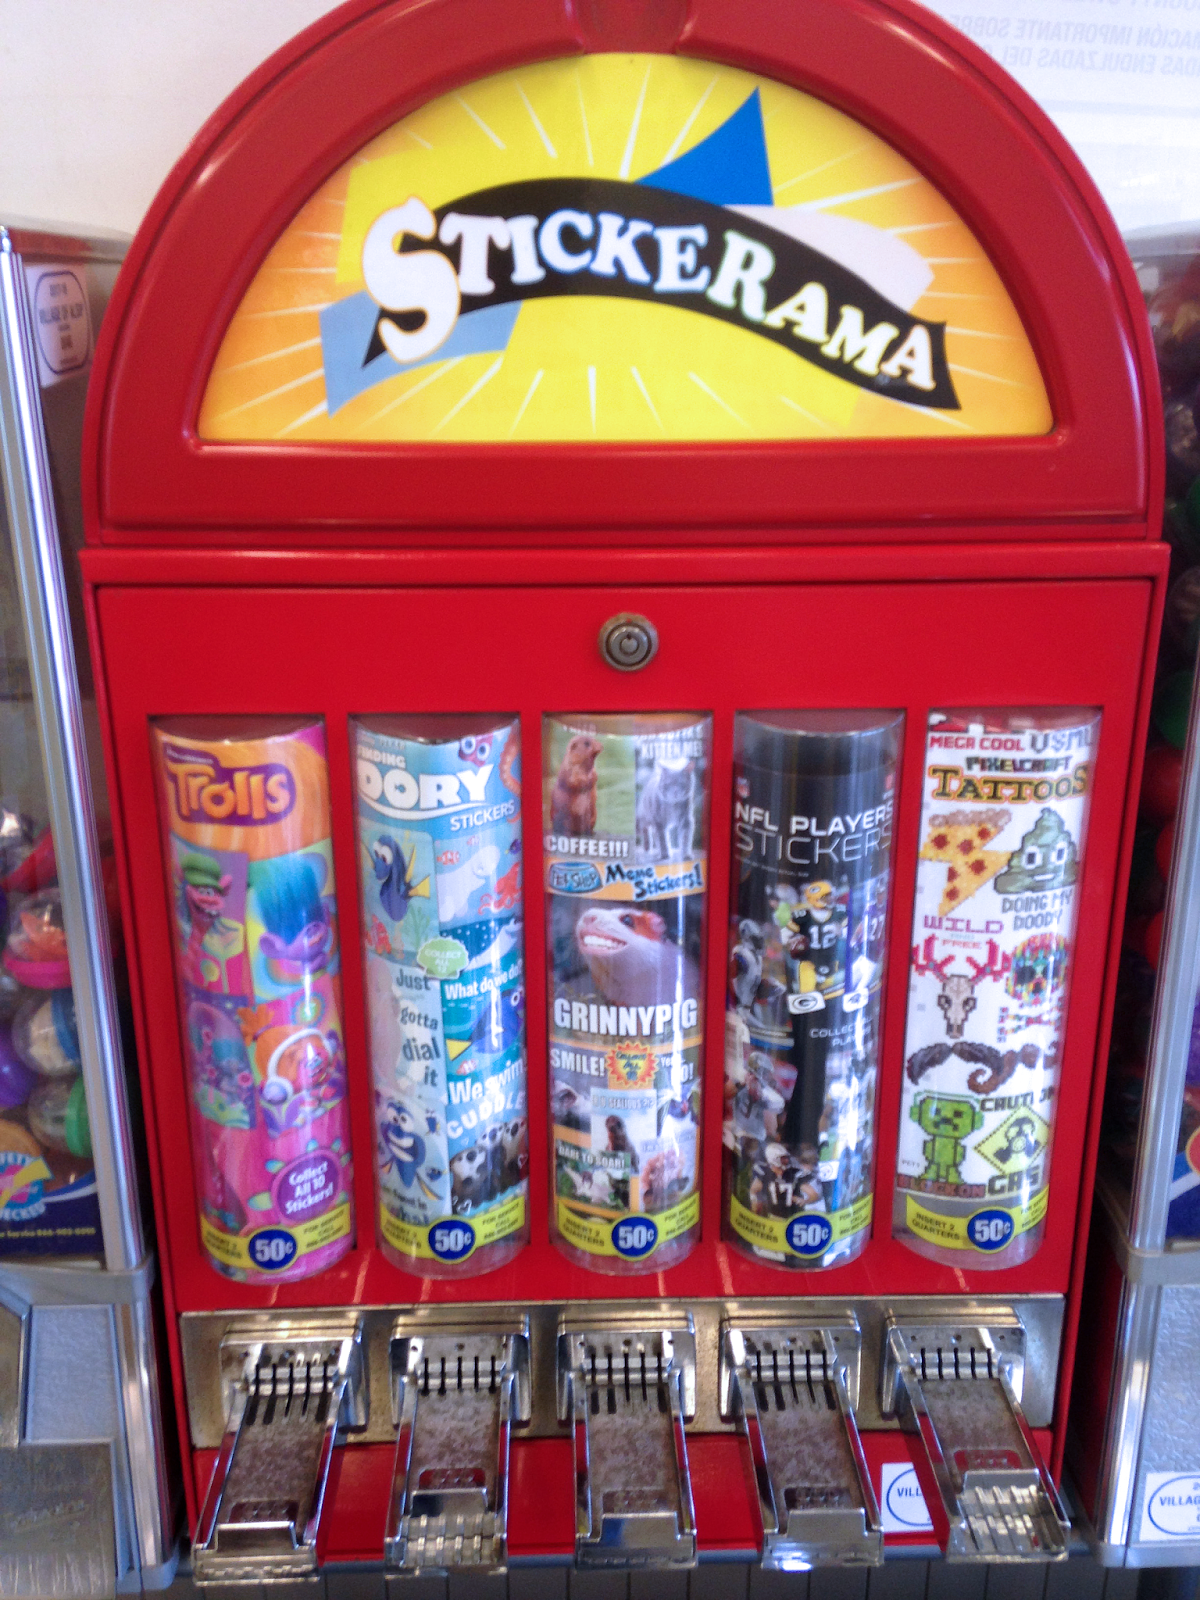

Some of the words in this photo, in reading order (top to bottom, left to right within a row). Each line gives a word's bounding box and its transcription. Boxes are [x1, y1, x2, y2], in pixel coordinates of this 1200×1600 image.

[361, 195, 937, 391] STICKERAMA
[979, 736, 1025, 751] COOL
[356, 764, 494, 811] DORY
[930, 764, 1089, 802] TATTOOS
[450, 799, 515, 831] STICKERS
[735, 801, 779, 831] NFL
[544, 835, 629, 858] COFFEE!!!
[634, 864, 704, 901] Stickers!
[1002, 894, 1048, 914] DOING
[808, 923, 838, 950] 12
[924, 914, 1004, 935] WILD
[396, 967, 431, 992] Just
[443, 981, 479, 1001] What
[480, 977, 493, 994] do
[493, 971, 508, 988] we
[400, 1005, 439, 1032] gotta
[553, 997, 698, 1038] GRINNYPIG
[402, 1036, 441, 1062] dial
[550, 1048, 605, 1077] SMILE!
[423, 1065, 439, 1087] it
[449, 1078, 483, 1105] We
[288, 1160, 329, 1186] Collect
[284, 1181, 334, 1215] Stickers!
[294, 1181, 312, 1199] All
[768, 1180, 793, 1206] 17
[735, 1217, 779, 1244] QUARTERS
[911, 1218, 960, 1241] QUARTERS
[915, 1211, 948, 1230] INSERT
